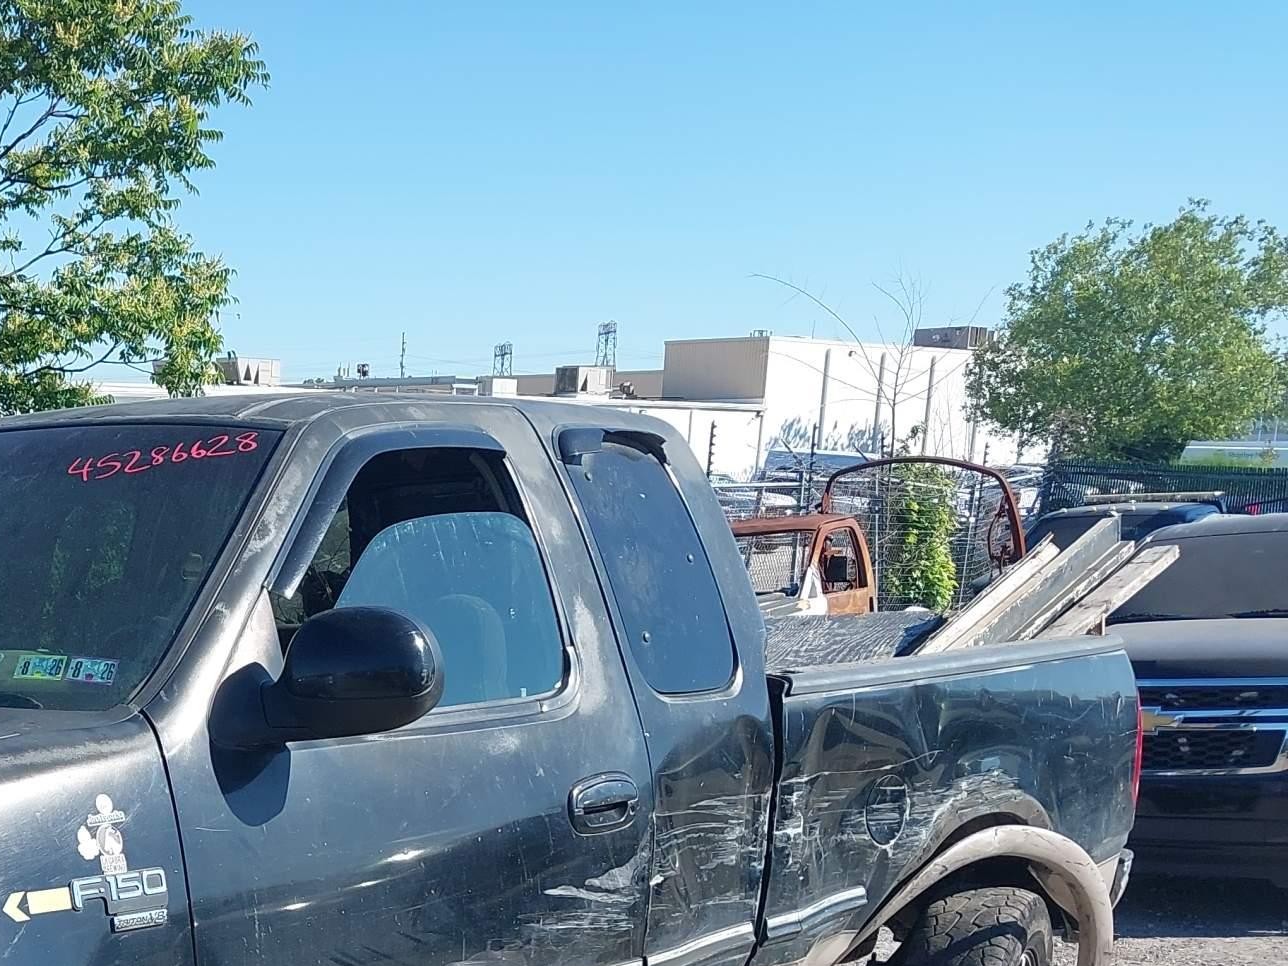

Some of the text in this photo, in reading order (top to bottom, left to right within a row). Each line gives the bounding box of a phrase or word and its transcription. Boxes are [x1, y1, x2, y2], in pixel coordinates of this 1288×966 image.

[67, 431, 259, 482] 45286628
[48, 658, 63, 677] 26
[100, 662, 116, 680] 26
